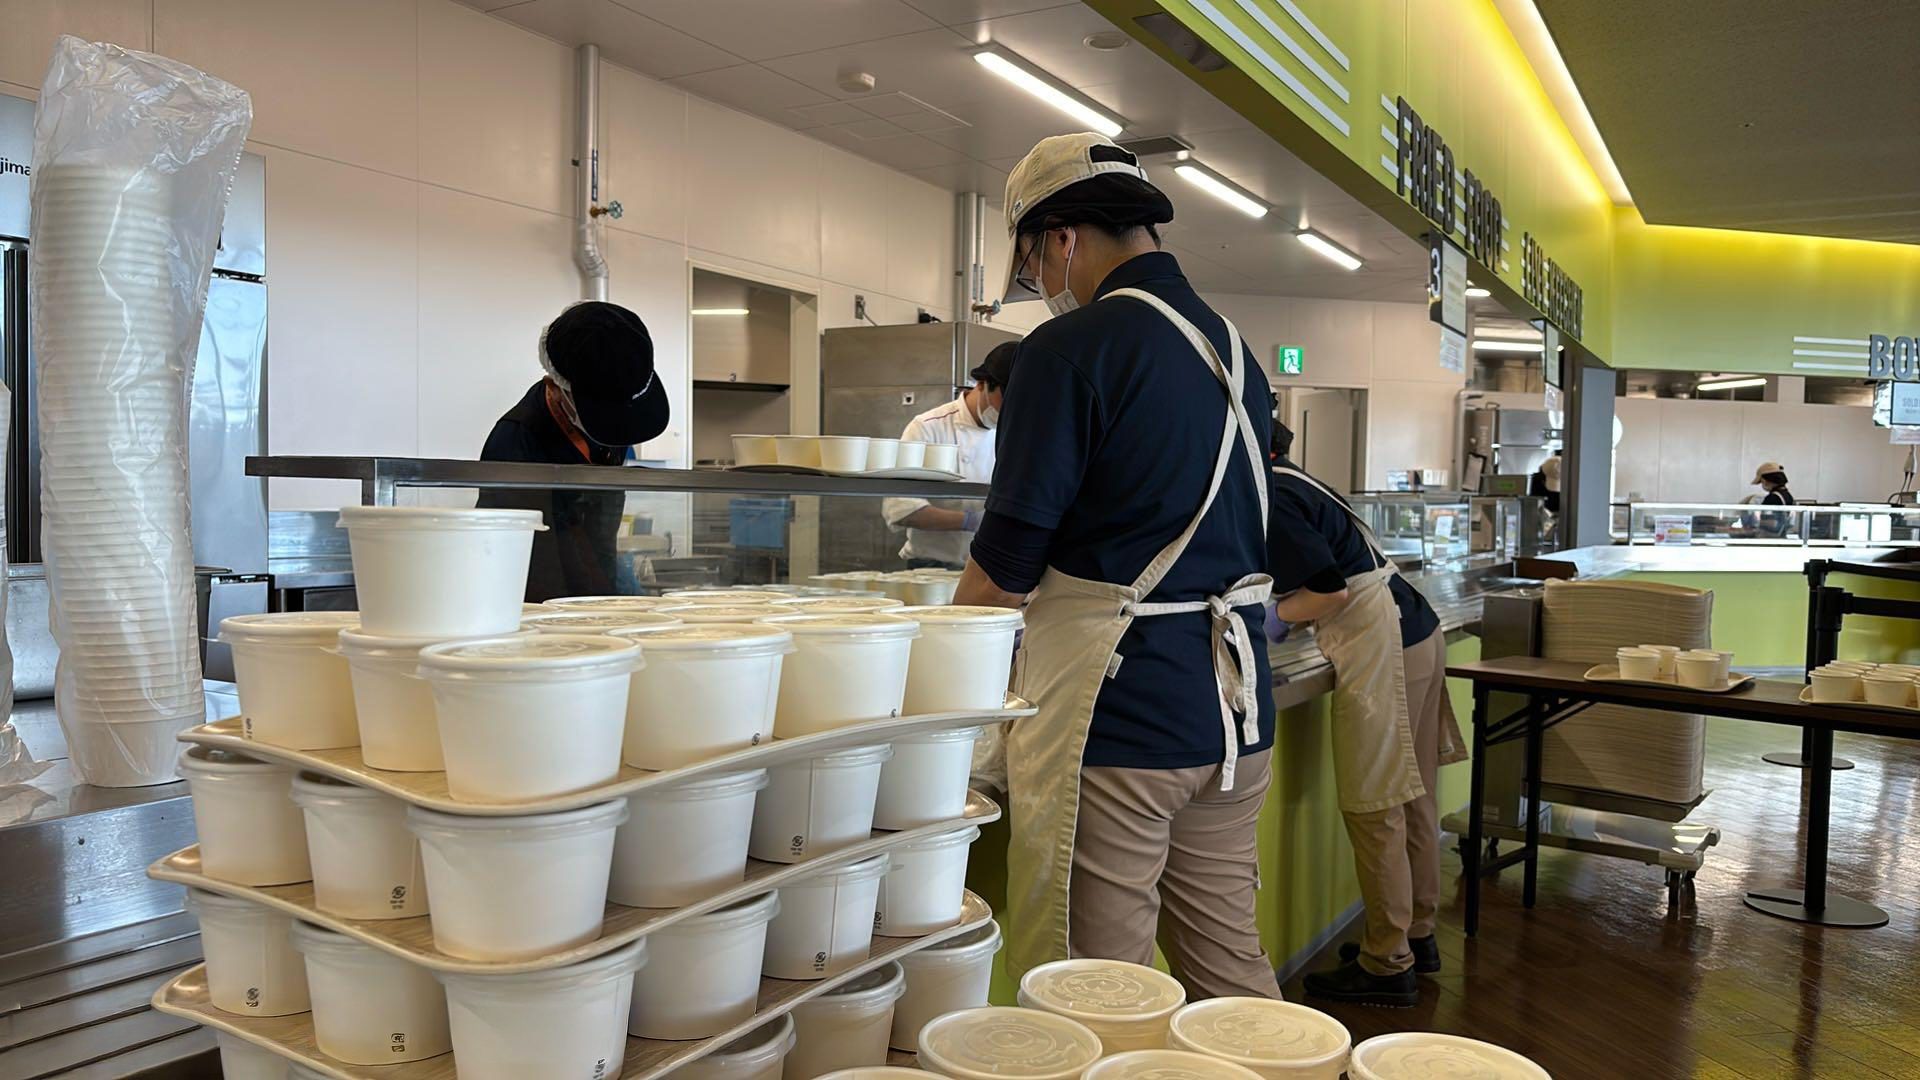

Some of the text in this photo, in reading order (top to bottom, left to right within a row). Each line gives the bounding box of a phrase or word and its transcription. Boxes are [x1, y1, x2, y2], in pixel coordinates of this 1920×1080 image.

[1397, 95, 1503, 274] FRIED FOOD
[1430, 247, 1441, 297] 3
[1868, 333, 1920, 380] BO
